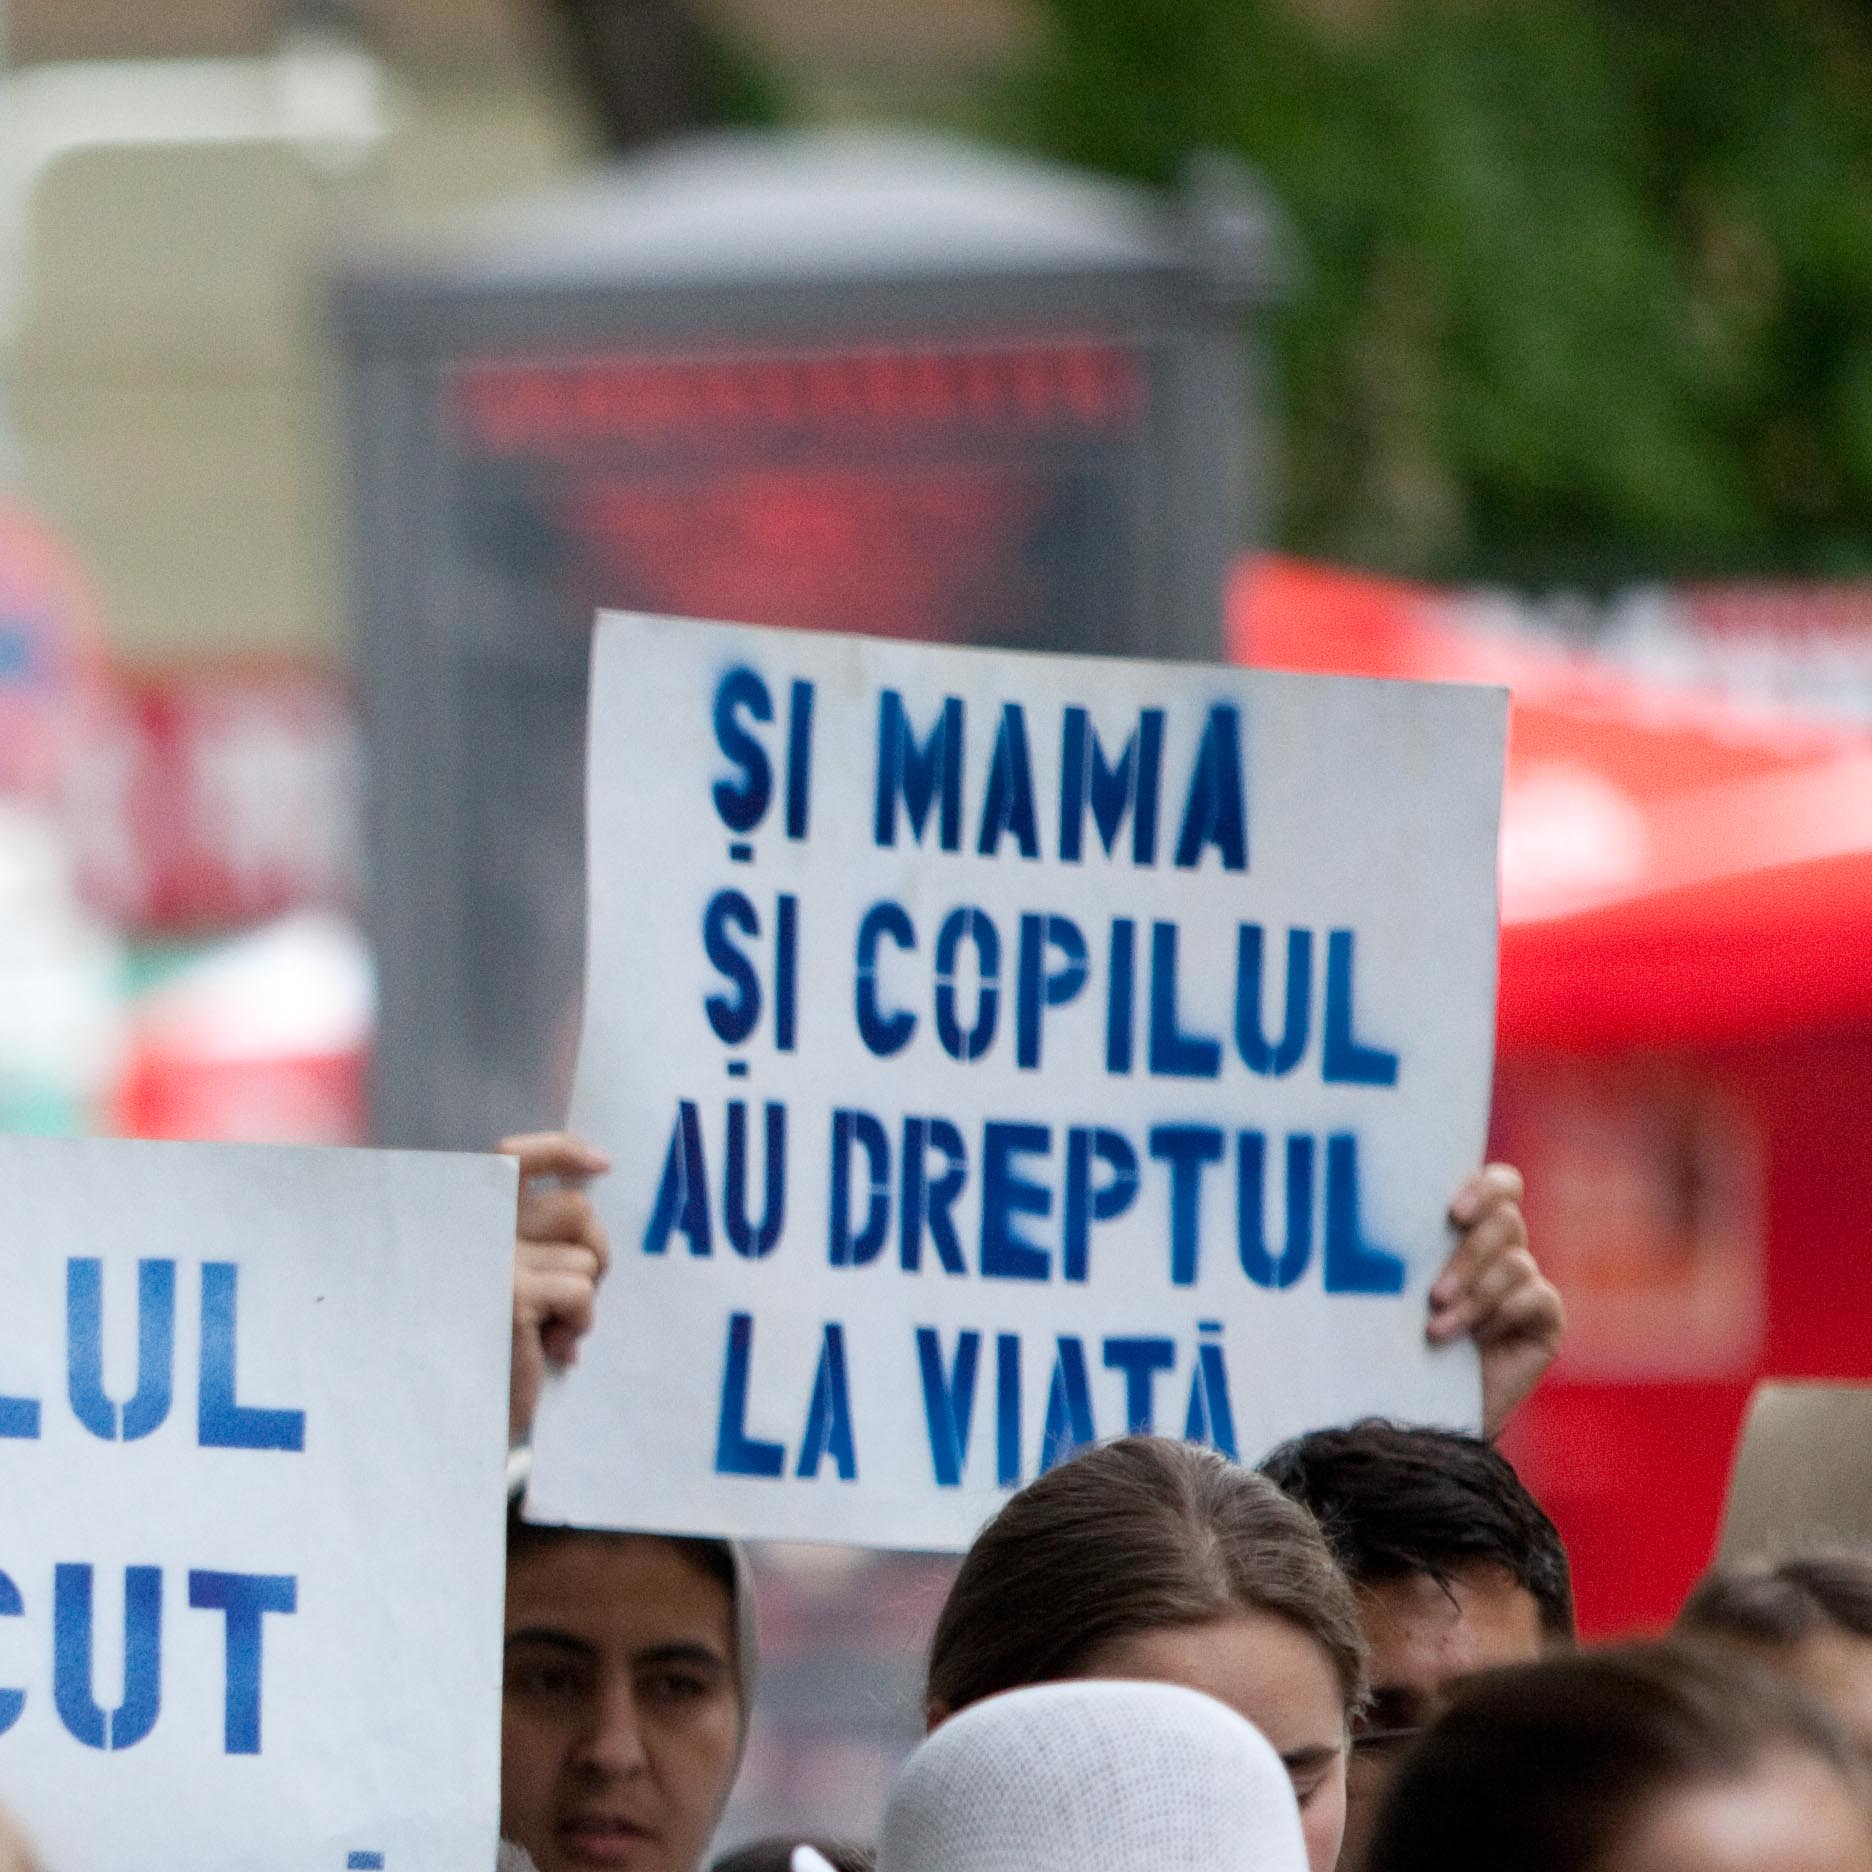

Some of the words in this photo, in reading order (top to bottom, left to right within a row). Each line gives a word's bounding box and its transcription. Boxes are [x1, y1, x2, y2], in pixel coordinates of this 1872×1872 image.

[870, 685, 1250, 873] MAMA
[852, 898, 1402, 1088] COPILUL
[638, 1096, 788, 1262] AU
[825, 1104, 1409, 1298] DREPTUL
[711, 1309, 860, 1483] LA
